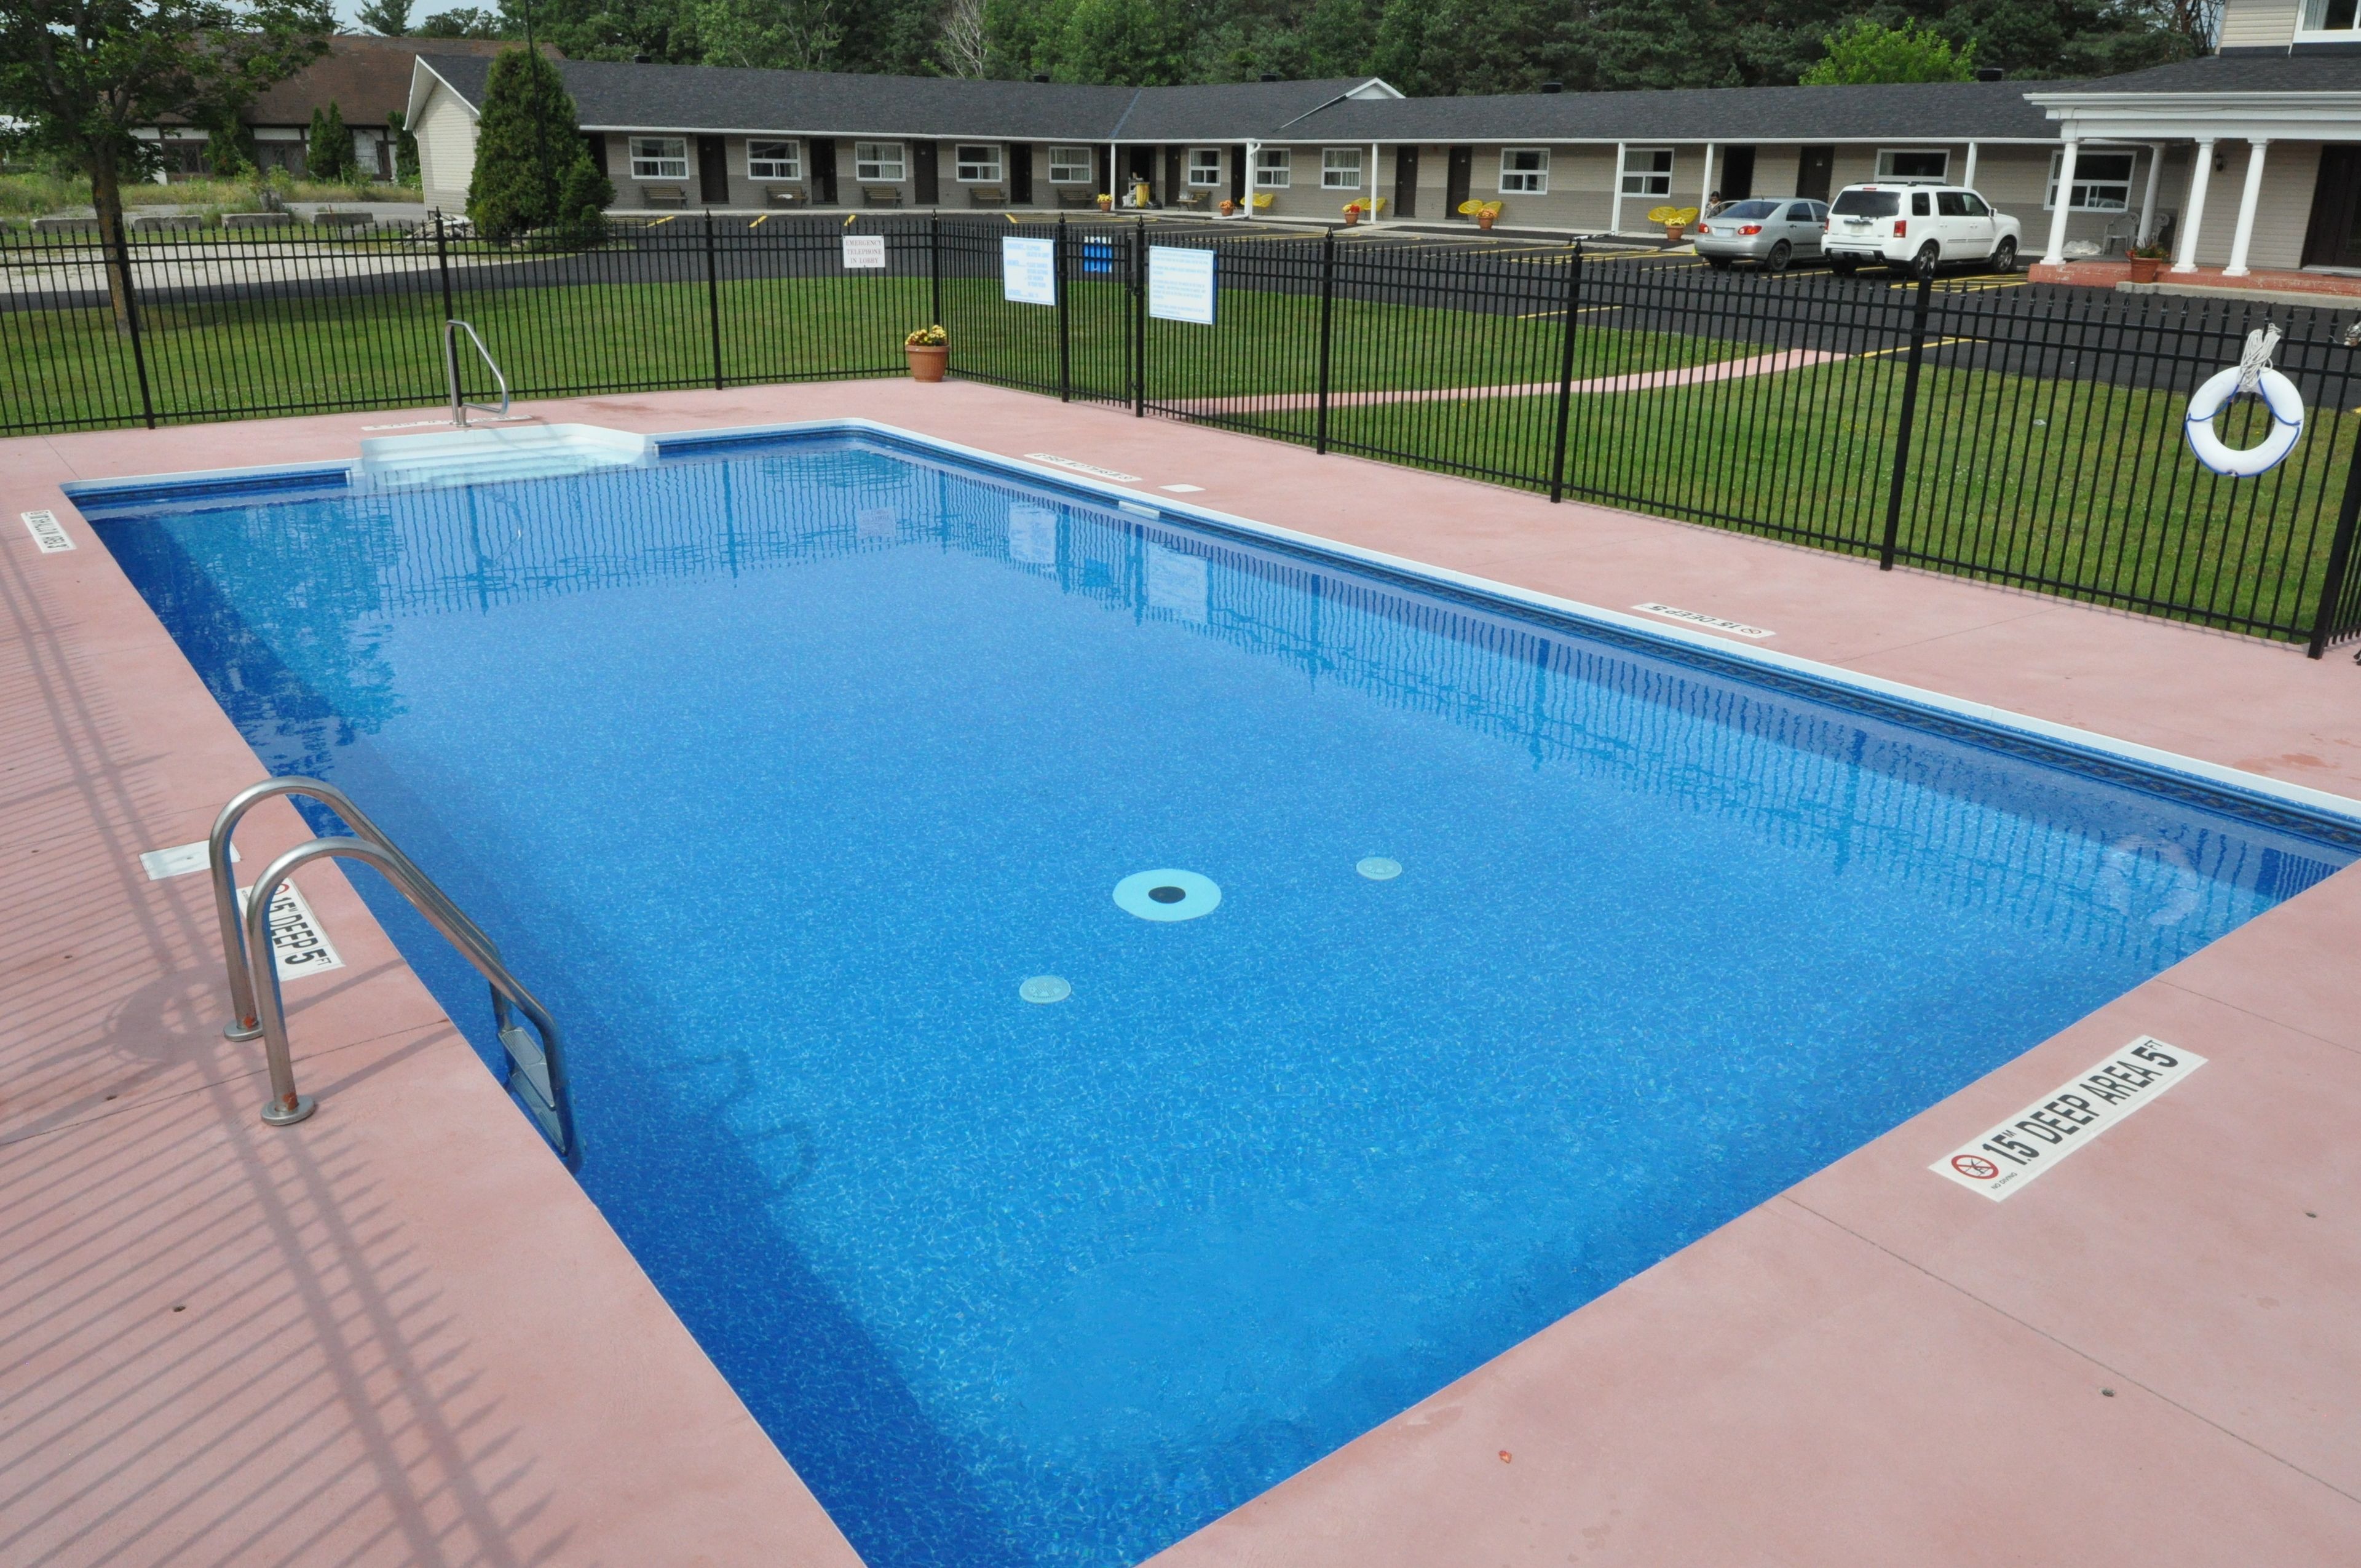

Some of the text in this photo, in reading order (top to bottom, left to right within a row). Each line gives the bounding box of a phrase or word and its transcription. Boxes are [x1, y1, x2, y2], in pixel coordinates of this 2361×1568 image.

[1664, 610, 1717, 623] DEEP
[270, 914, 318, 948] DEEP
[2014, 1094, 2100, 1144] DEEP
[2079, 1061, 2163, 1106] AREA
[1999, 1171, 2018, 1184] DIVING
